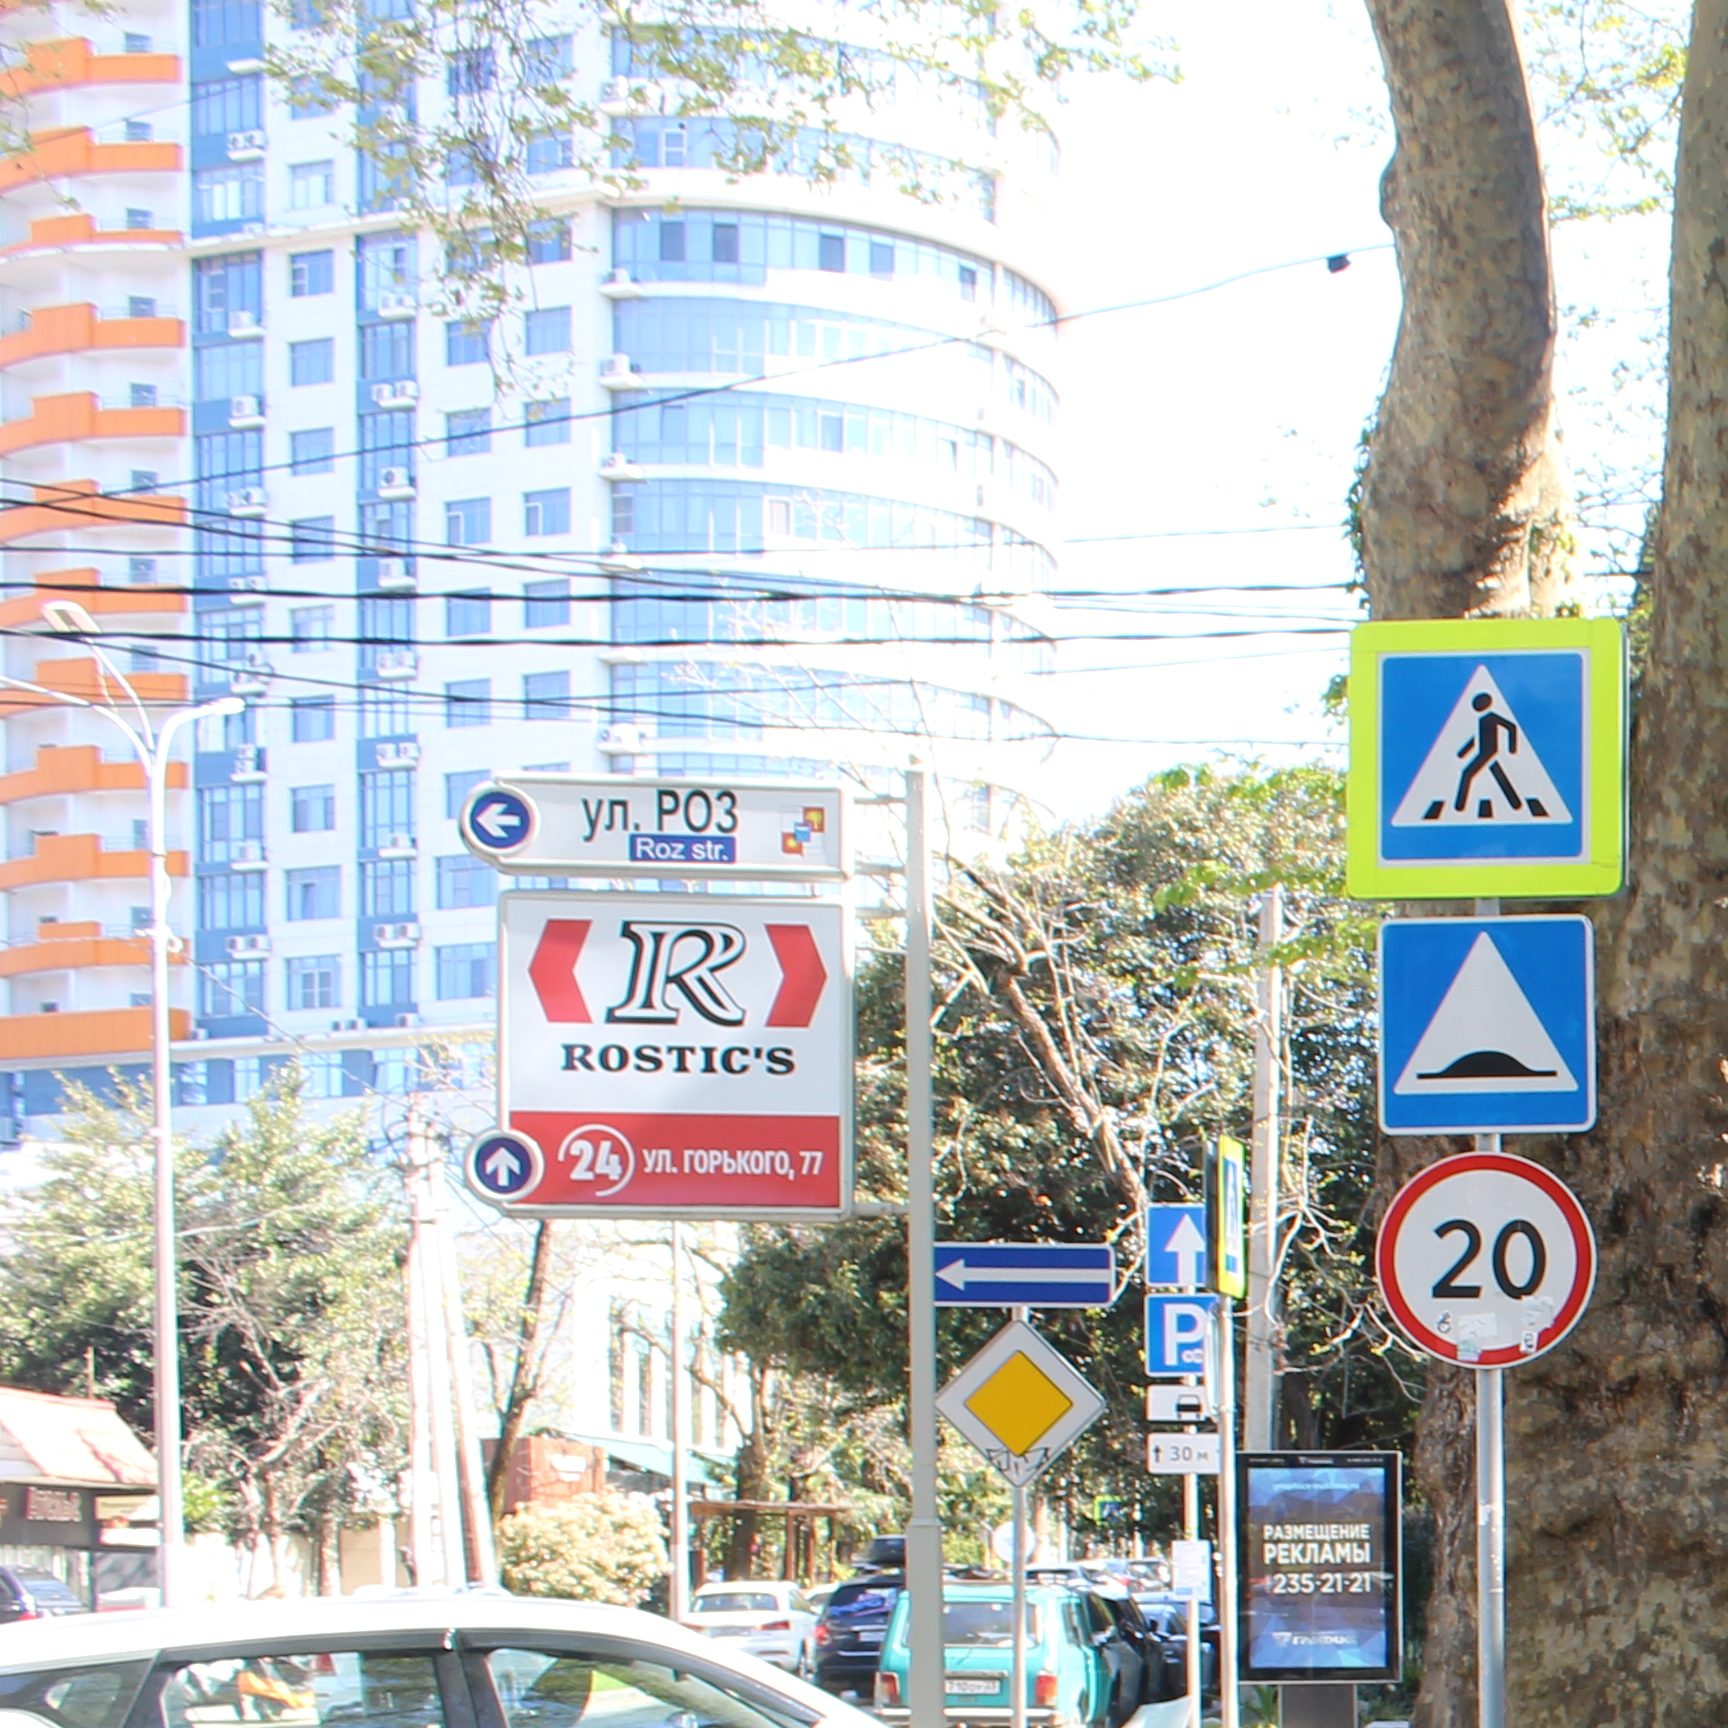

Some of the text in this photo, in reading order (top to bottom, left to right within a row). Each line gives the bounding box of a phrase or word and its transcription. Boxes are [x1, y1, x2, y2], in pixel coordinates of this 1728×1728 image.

[581, 789, 740, 843] ул. РОЗ
[635, 837, 730, 861] Roz str.
[561, 1043, 797, 1076] ROSTIC'S
[568, 1139, 824, 1182] 24 УЛ. ГОРЬКОГО, 77
[1431, 1218, 1548, 1300] 20
[1170, 1445, 1192, 1462] 30
[1262, 1523, 1372, 1541] РАЗМЕЩЕНИЕ
[1262, 1542, 1372, 1565] РЕКЛАМЫ
[1271, 1572, 1372, 1595] 235-21-21
